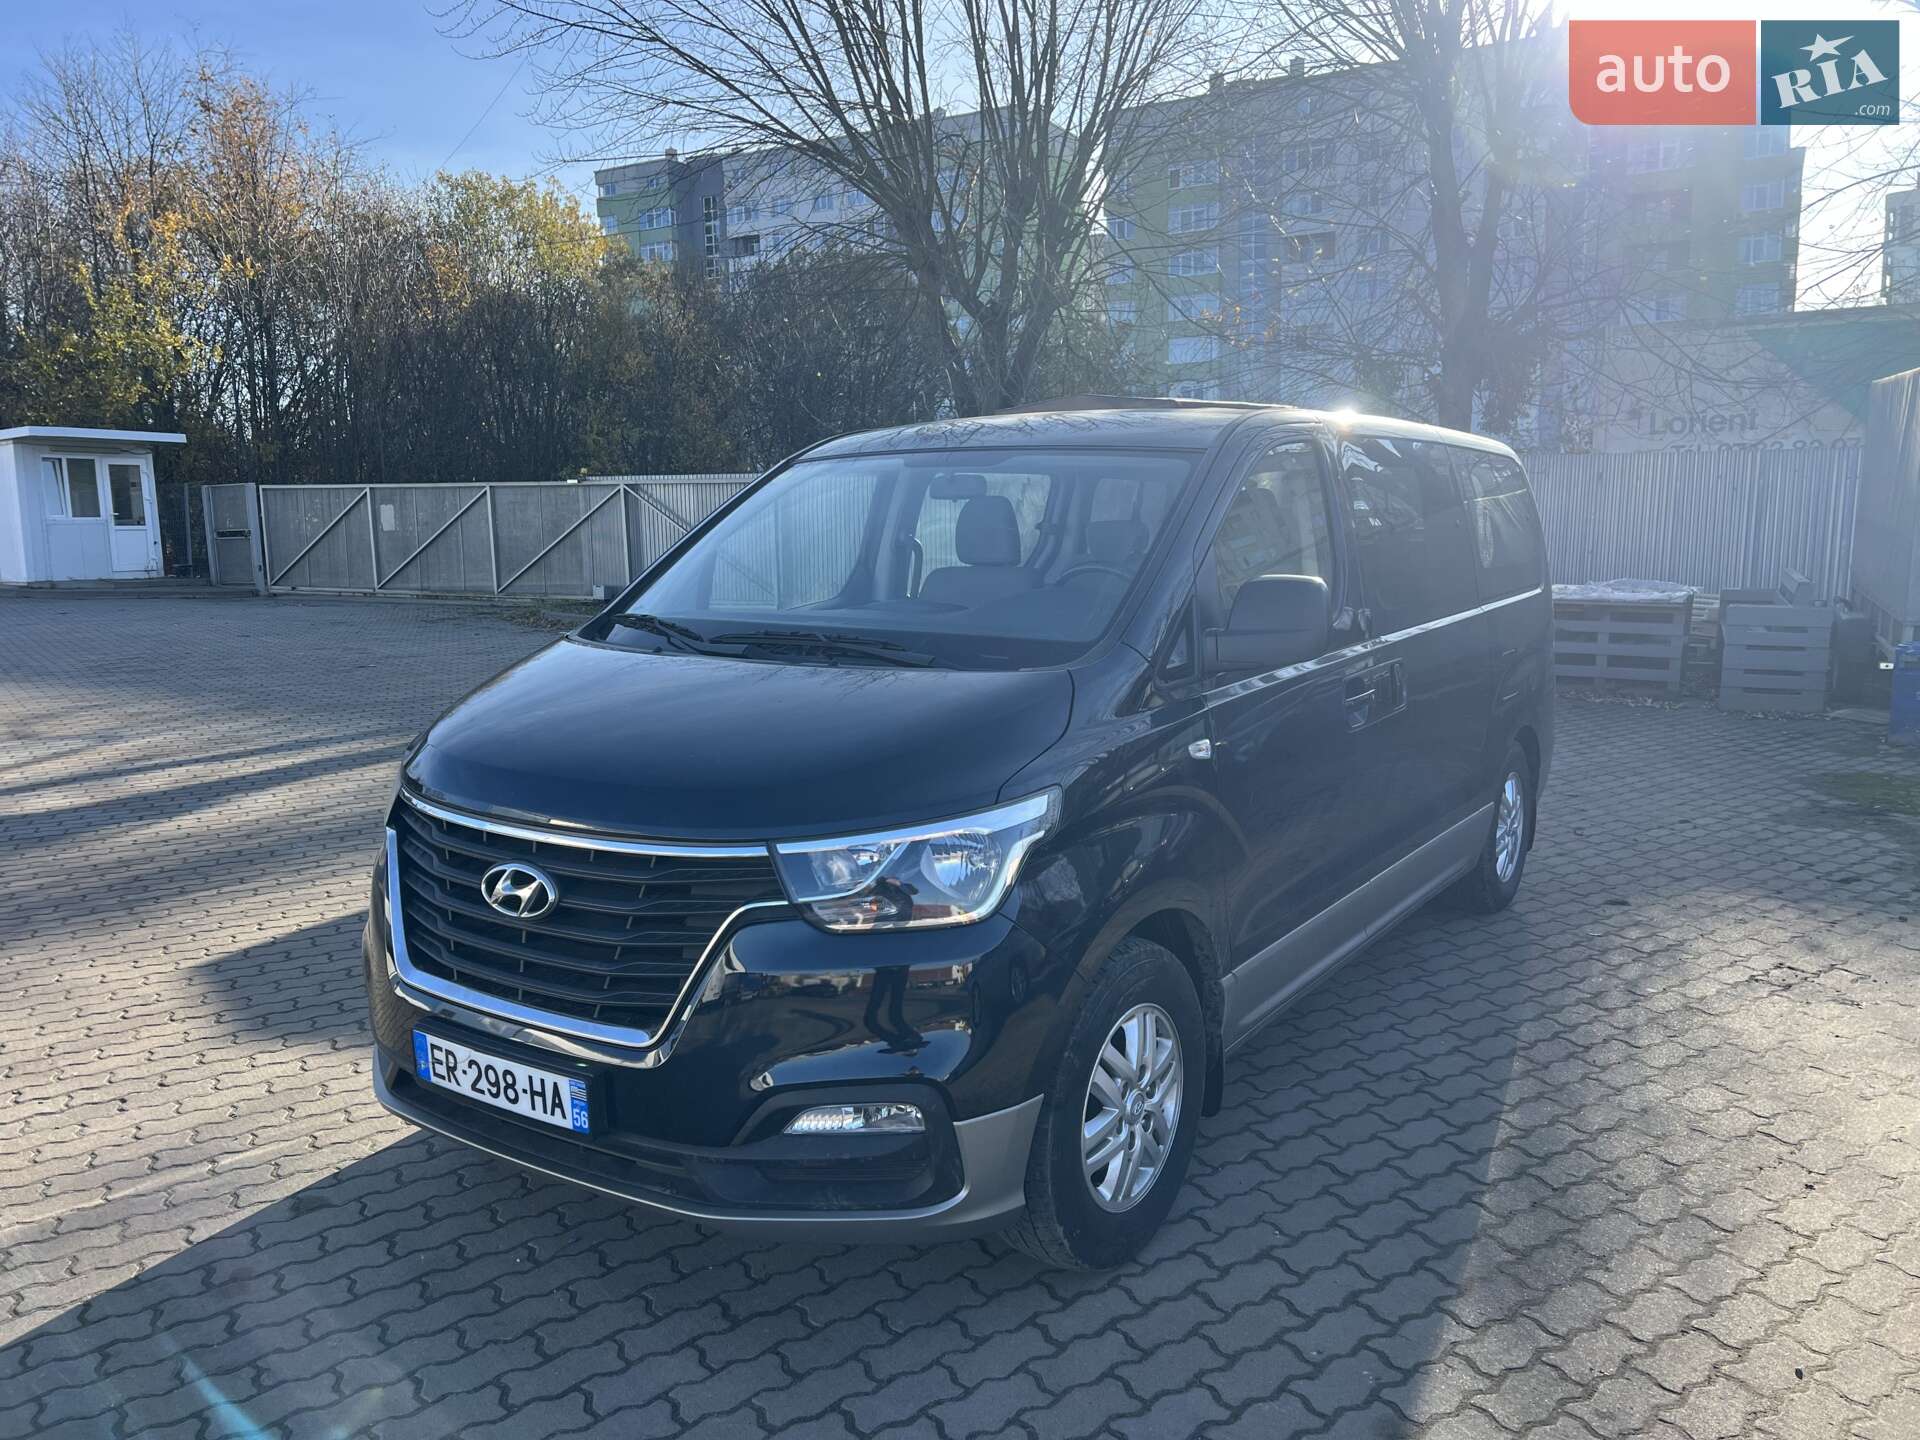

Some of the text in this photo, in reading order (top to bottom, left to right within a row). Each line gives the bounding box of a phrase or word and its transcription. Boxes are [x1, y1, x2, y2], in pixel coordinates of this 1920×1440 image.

[1650, 407, 1760, 436] Lorient
[429, 1042, 567, 1120] ER-298-HA
[572, 1108, 589, 1129] 56
